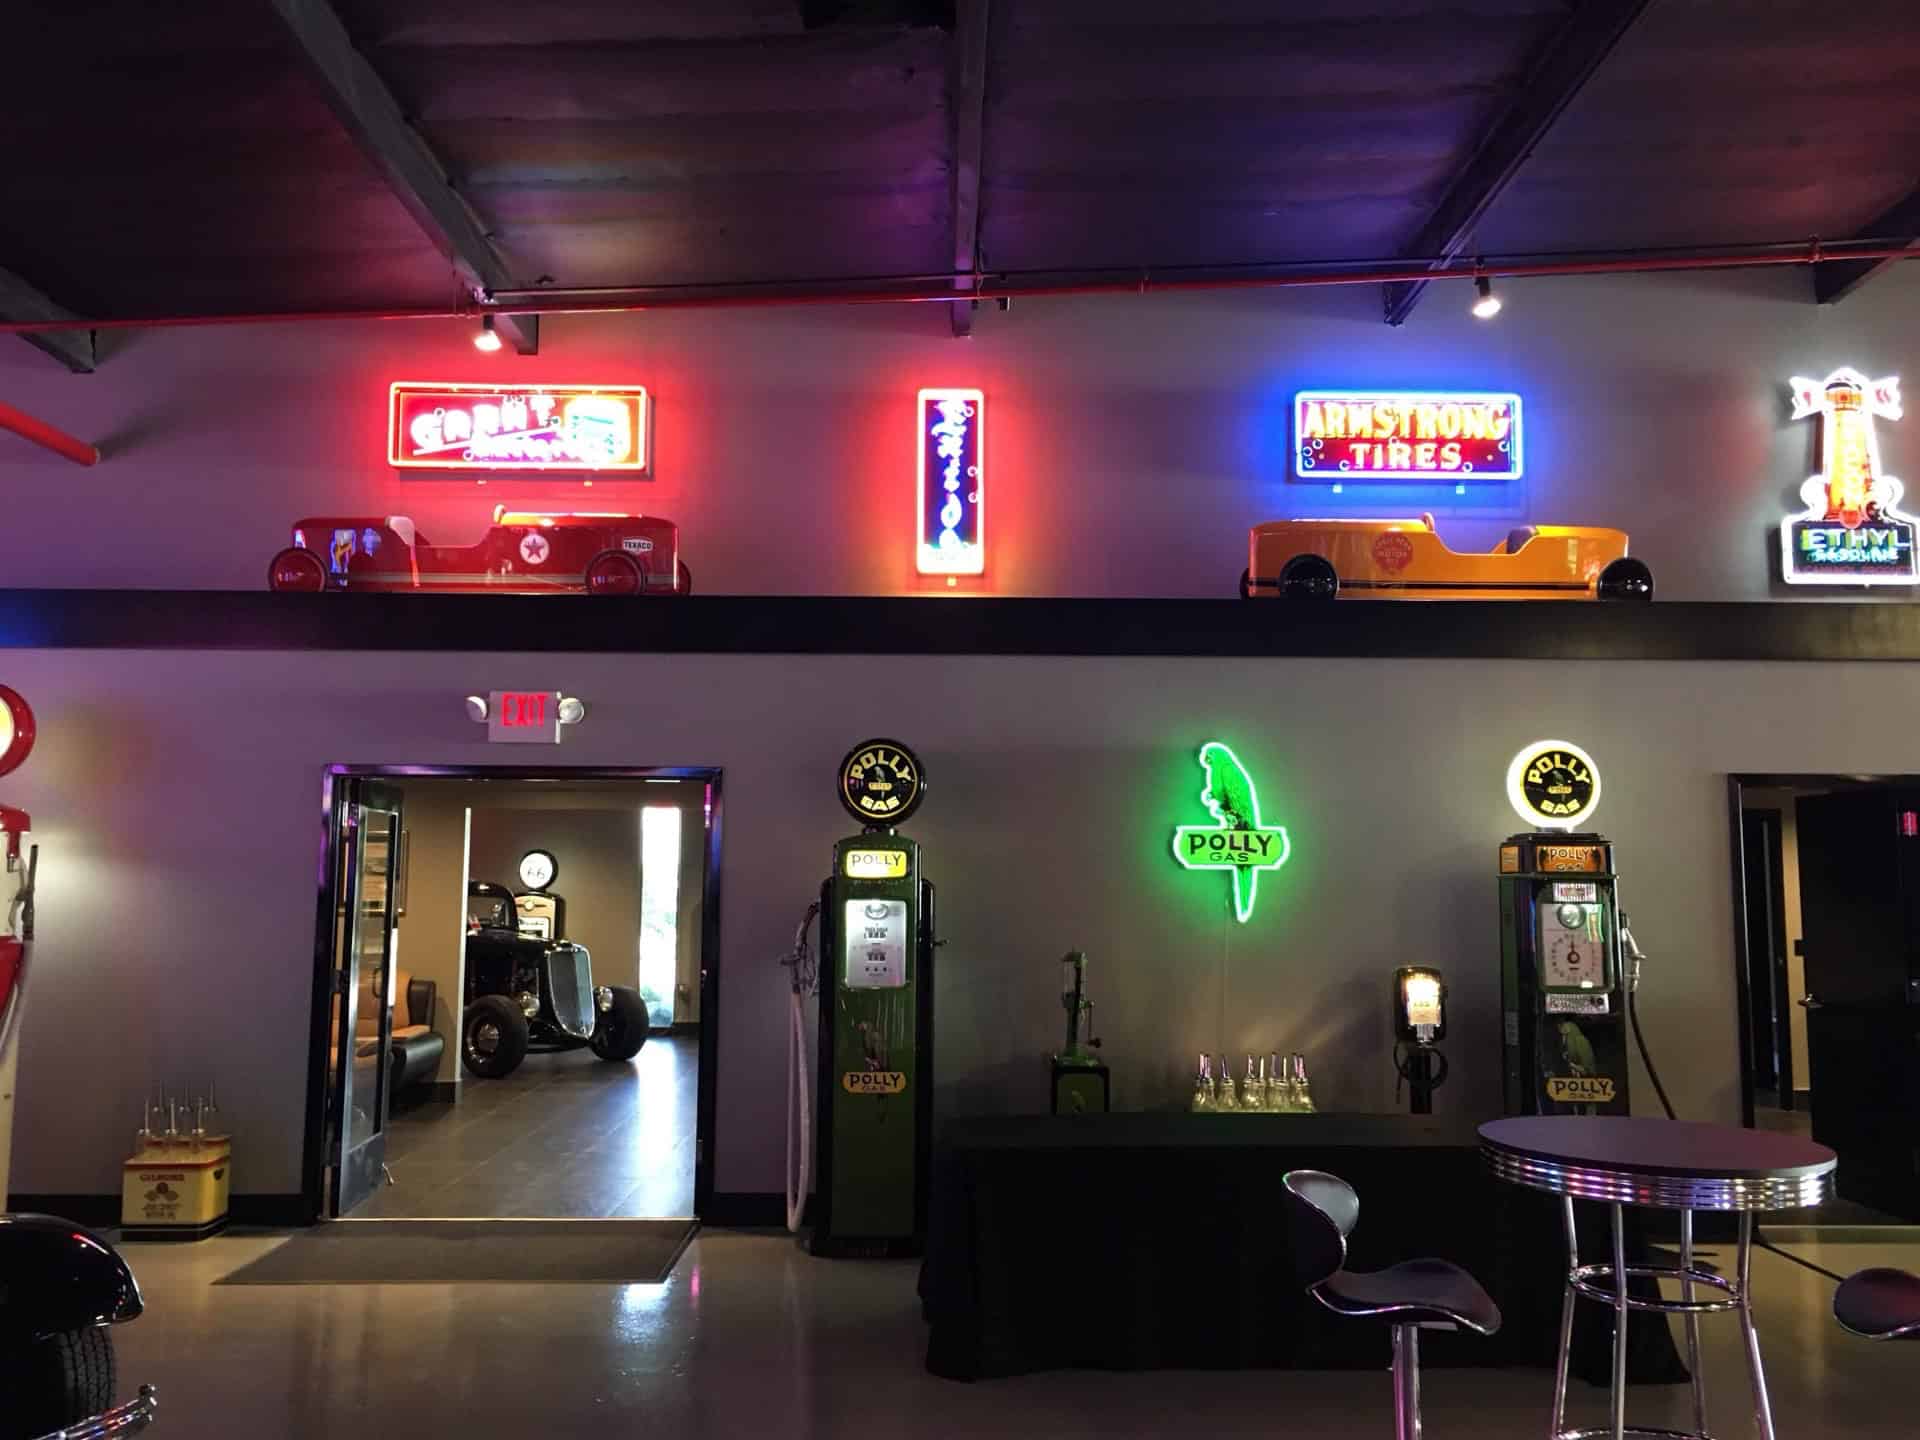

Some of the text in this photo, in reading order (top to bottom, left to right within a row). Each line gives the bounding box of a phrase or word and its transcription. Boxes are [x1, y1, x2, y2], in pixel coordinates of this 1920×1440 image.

[1302, 400, 1511, 440] ARMSTRONG
[1350, 443, 1462, 470] TIRES
[1802, 528, 1910, 550] ETHYL
[503, 692, 548, 727] EXIT
[850, 750, 913, 781] POLLY
[1528, 753, 1591, 784] POLLY
[1188, 834, 1272, 857] POLLY
[1551, 848, 1589, 864] POLLY
[851, 854, 903, 867] POLLY
[1209, 852, 1249, 862] GAS
[849, 1074, 900, 1088] POLLY
[1552, 1080, 1609, 1096] POLLY
